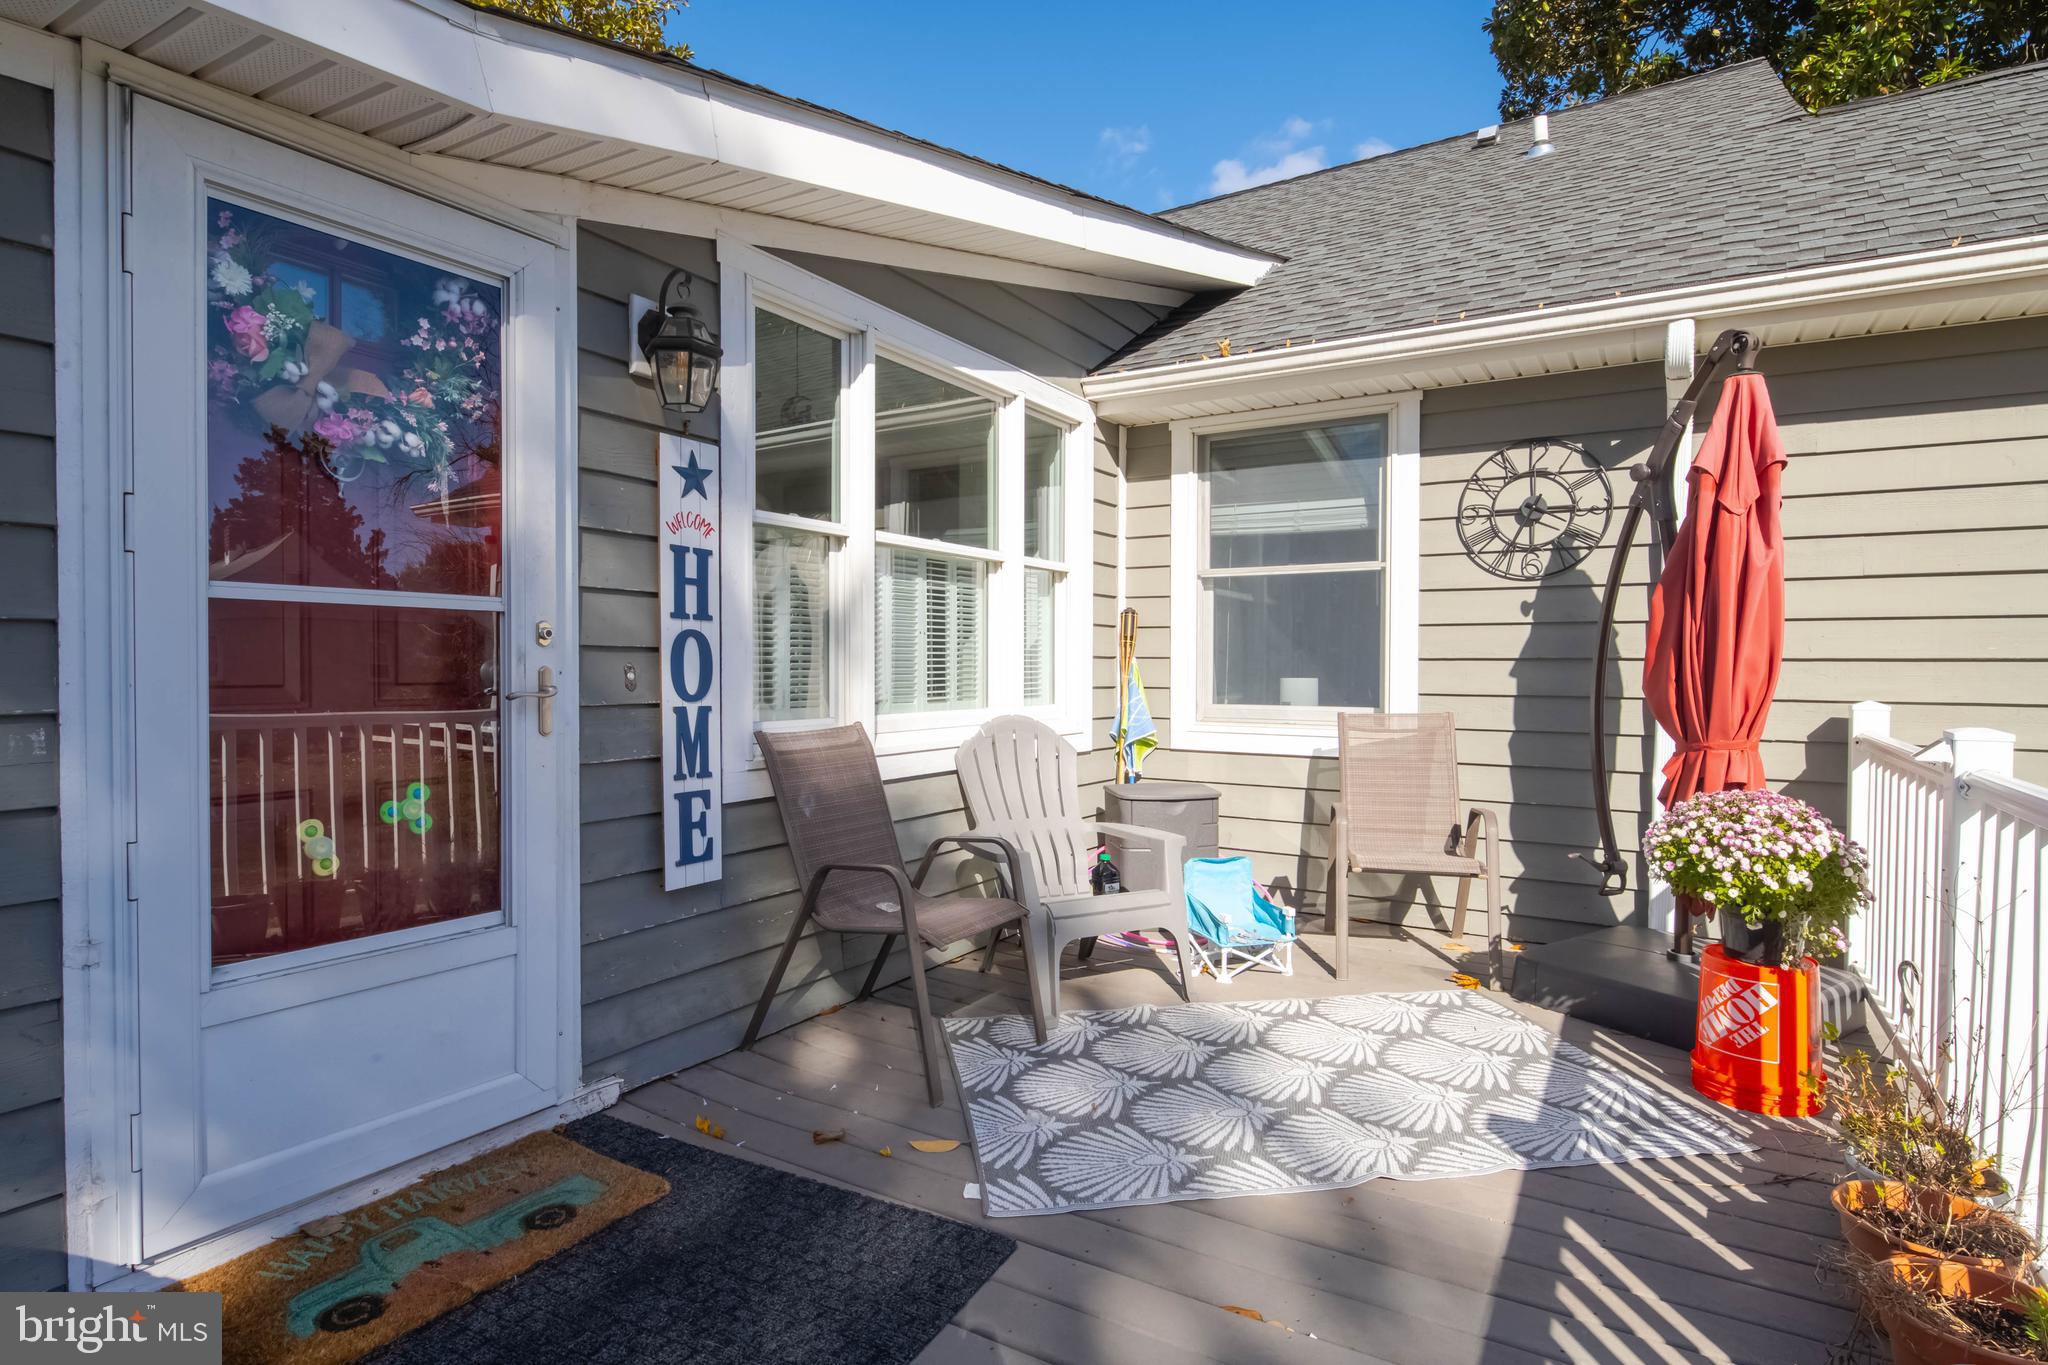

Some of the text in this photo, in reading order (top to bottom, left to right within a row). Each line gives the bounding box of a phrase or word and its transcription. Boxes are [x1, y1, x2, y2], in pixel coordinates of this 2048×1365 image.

[665, 511, 716, 539] WELCOME
[669, 543, 714, 868] HOME
[1700, 983, 1778, 1046] HOME
[1728, 1020, 1770, 1049] THE
